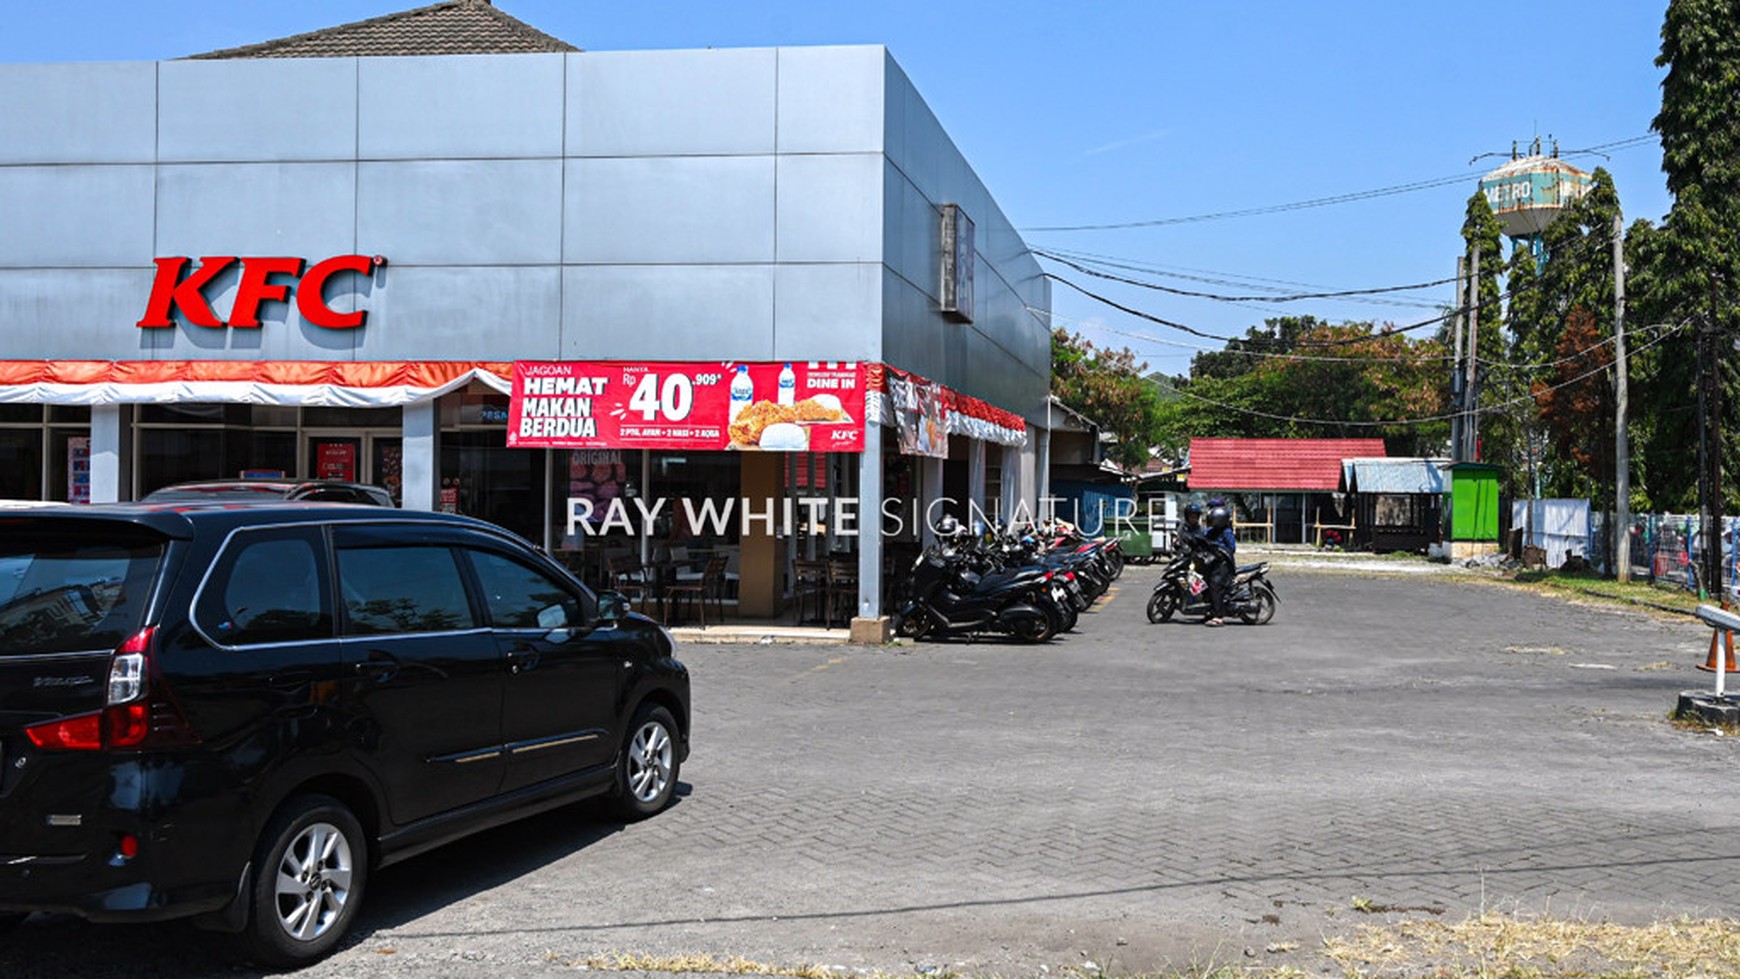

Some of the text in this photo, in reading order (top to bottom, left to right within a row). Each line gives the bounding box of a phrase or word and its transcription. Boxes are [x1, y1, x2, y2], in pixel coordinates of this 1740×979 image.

[525, 365, 572, 375] JAGOAN
[523, 377, 610, 395] HEMAT
[622, 373, 636, 388] Rp
[807, 378, 855, 388] DINE IN
[521, 397, 593, 417] MAKAN
[519, 418, 597, 437] BERDUA
[831, 430, 859, 440] KFC
